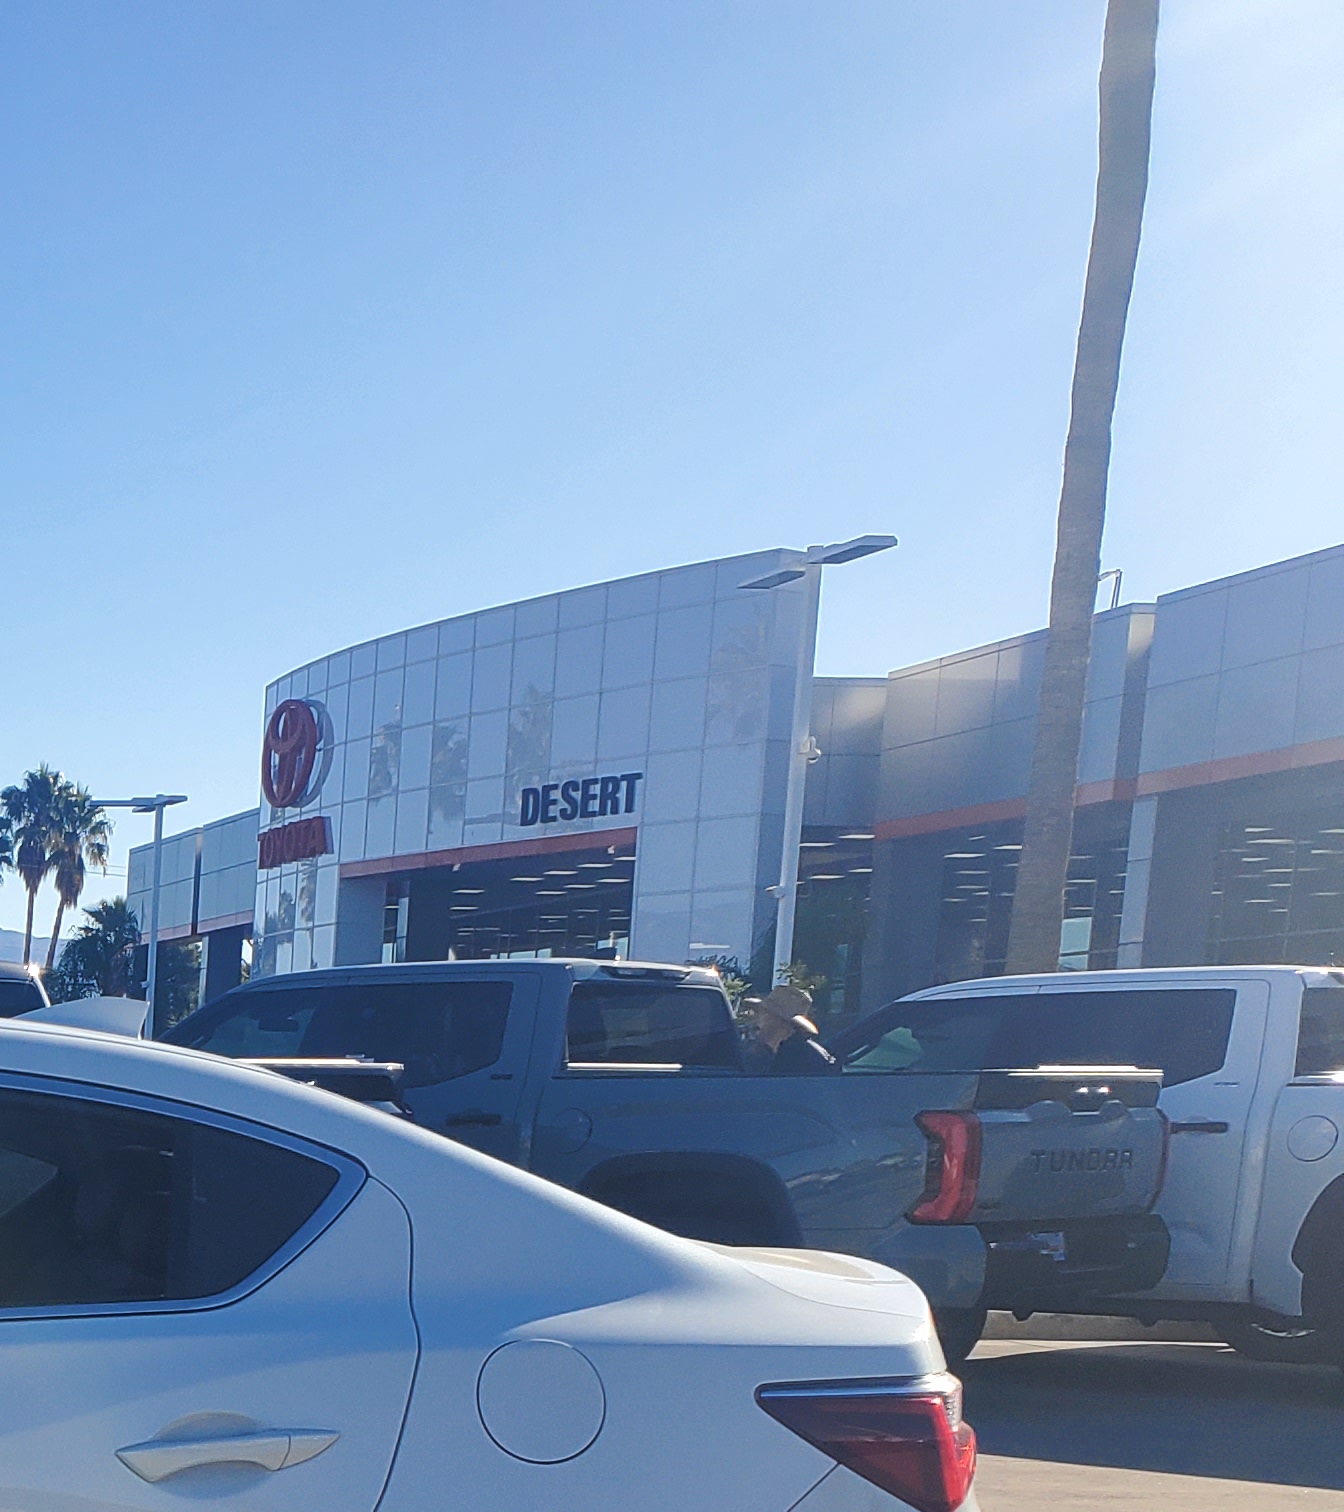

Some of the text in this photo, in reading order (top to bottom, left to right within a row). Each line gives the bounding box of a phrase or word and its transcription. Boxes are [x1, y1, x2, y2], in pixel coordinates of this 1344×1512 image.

[519, 771, 644, 827] DESERT
[256, 815, 328, 870] TOYOTA
[1030, 1147, 1132, 1175] TUNDRA
